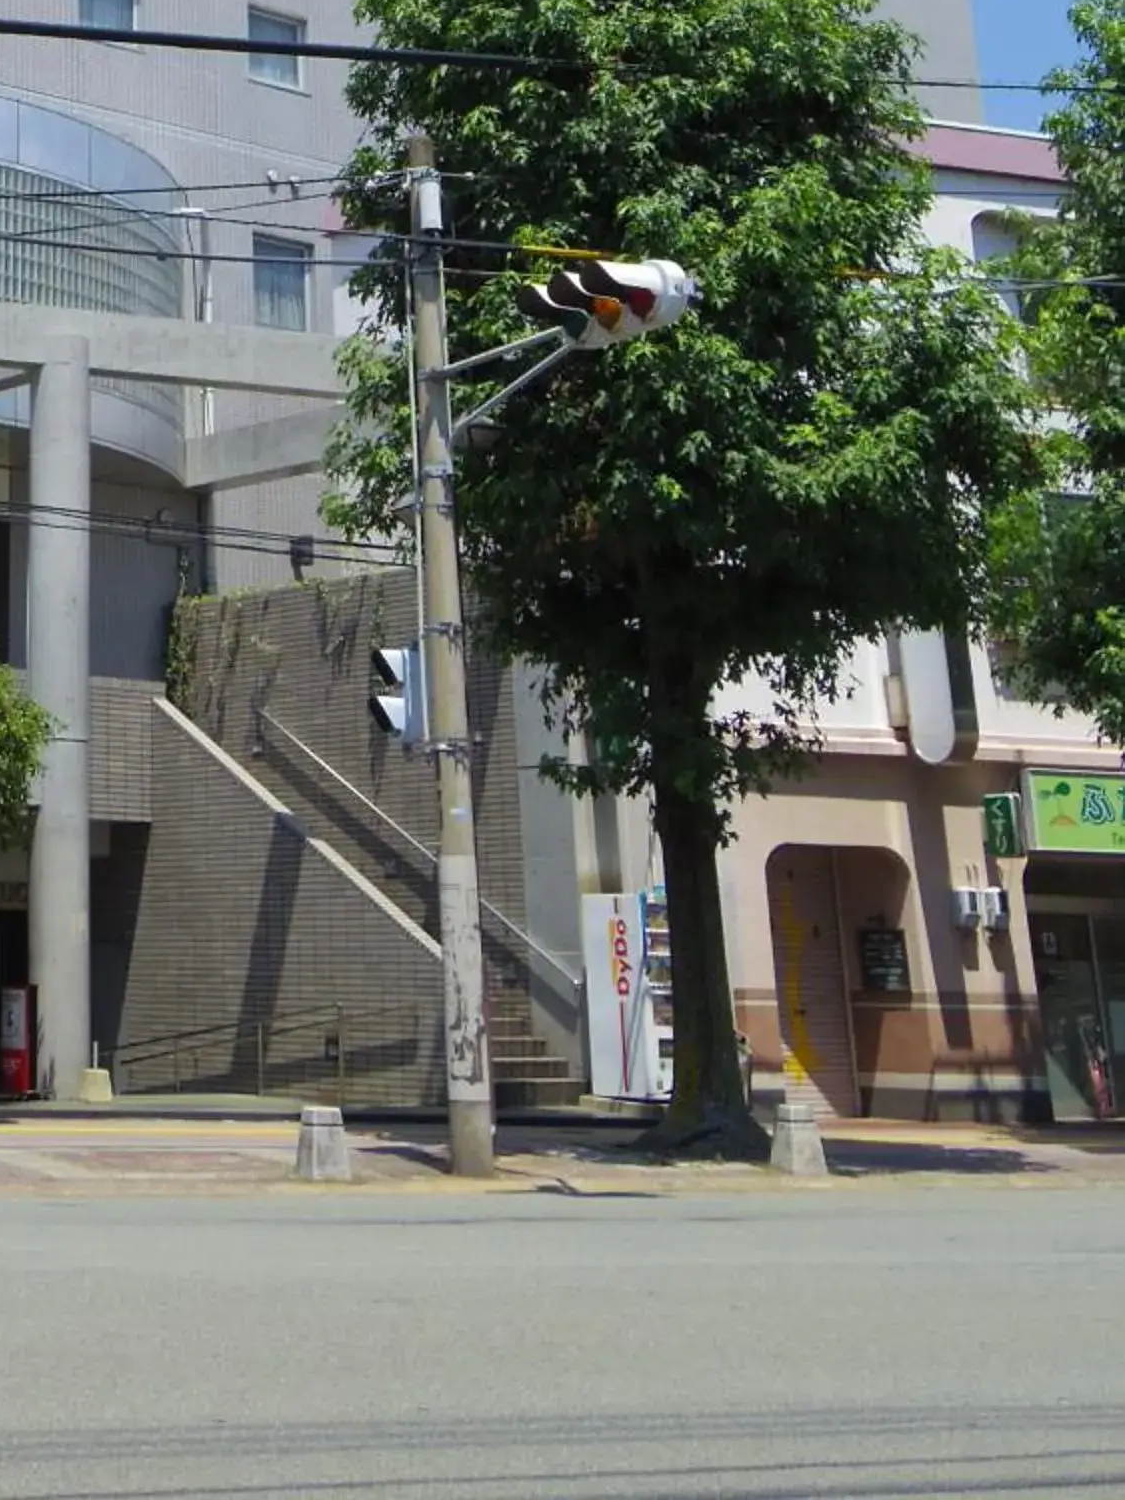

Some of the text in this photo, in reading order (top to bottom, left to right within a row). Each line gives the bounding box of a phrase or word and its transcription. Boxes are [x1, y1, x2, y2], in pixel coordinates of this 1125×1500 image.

[990, 799, 1008, 854] くすり
[614, 919, 632, 996] DyDo
